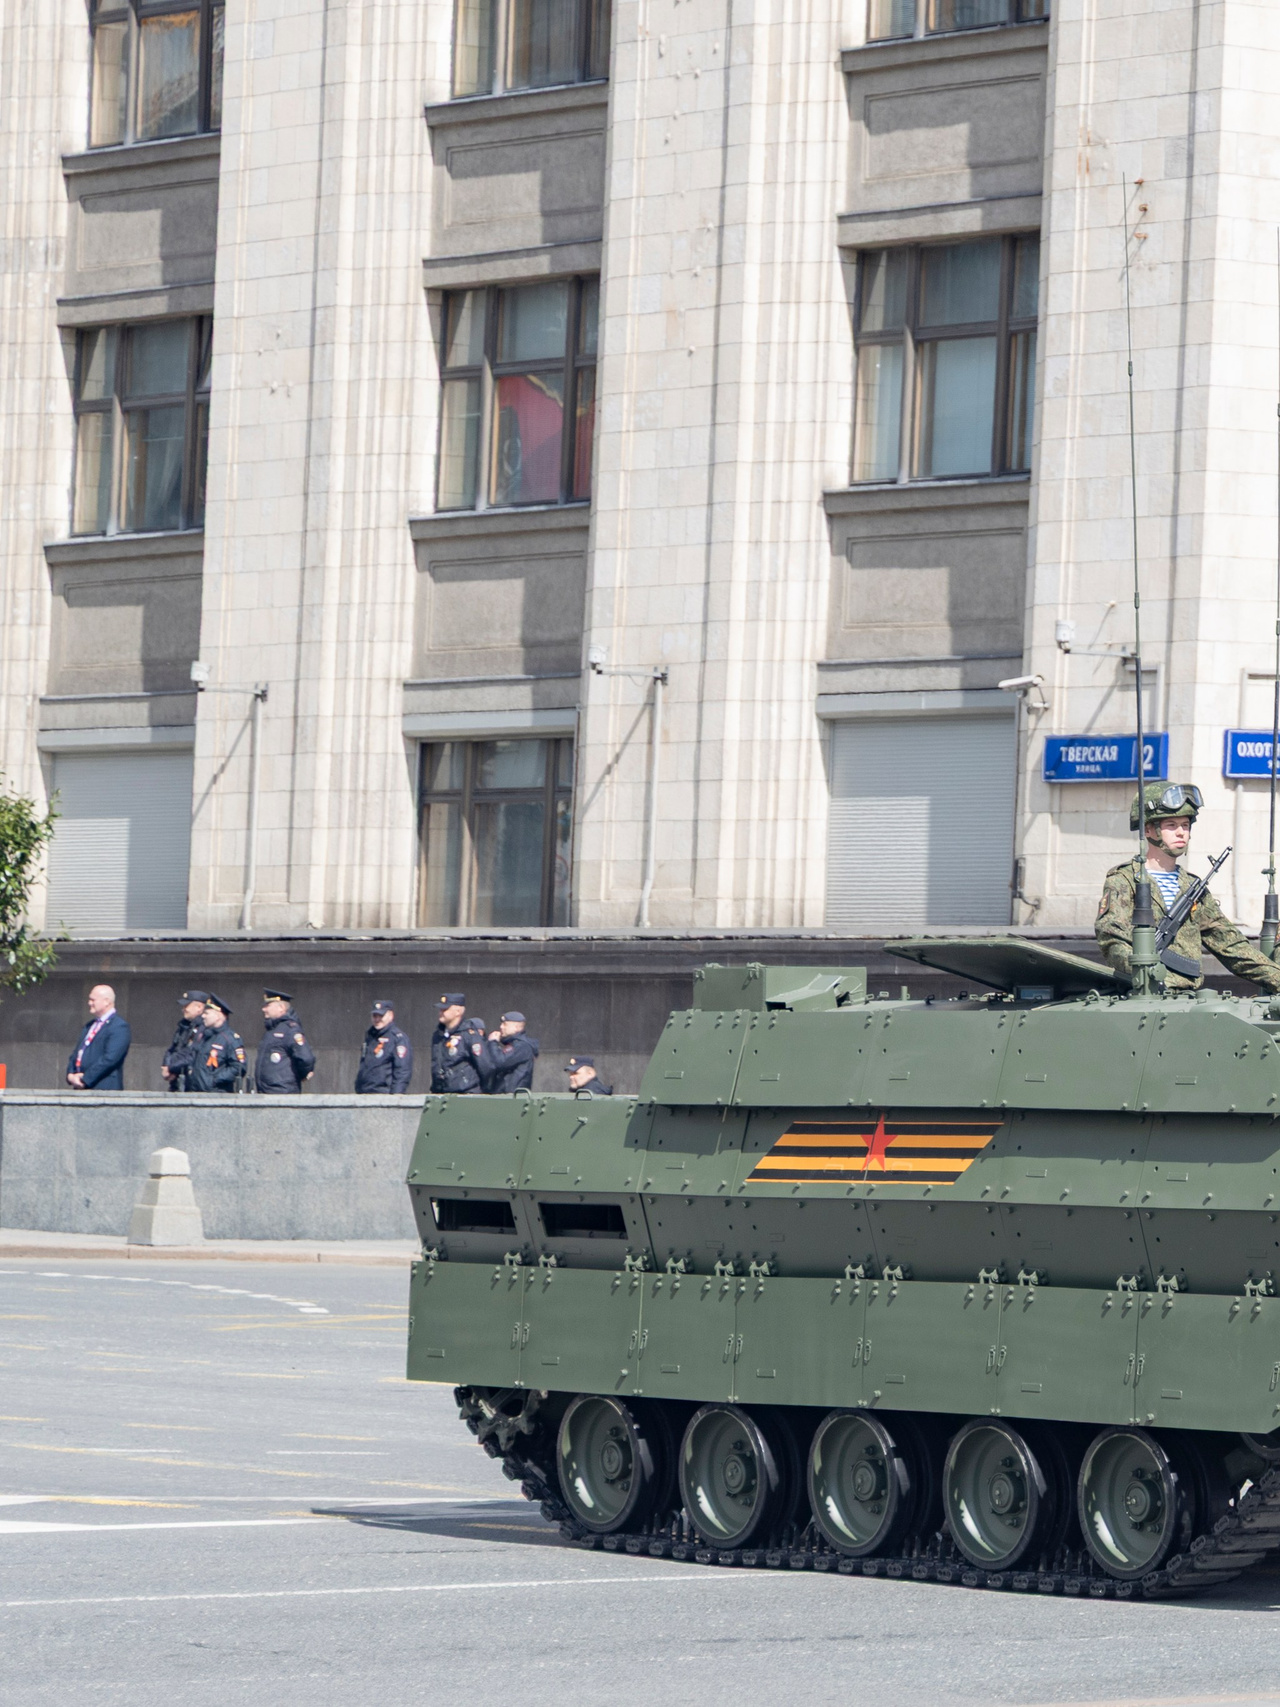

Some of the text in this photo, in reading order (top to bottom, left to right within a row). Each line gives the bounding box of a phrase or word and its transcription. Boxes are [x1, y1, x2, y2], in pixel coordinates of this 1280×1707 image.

[1060, 744, 1154, 770] ТВЕРСКАЯ 2
[1075, 764, 1101, 773] УЛИЦА
